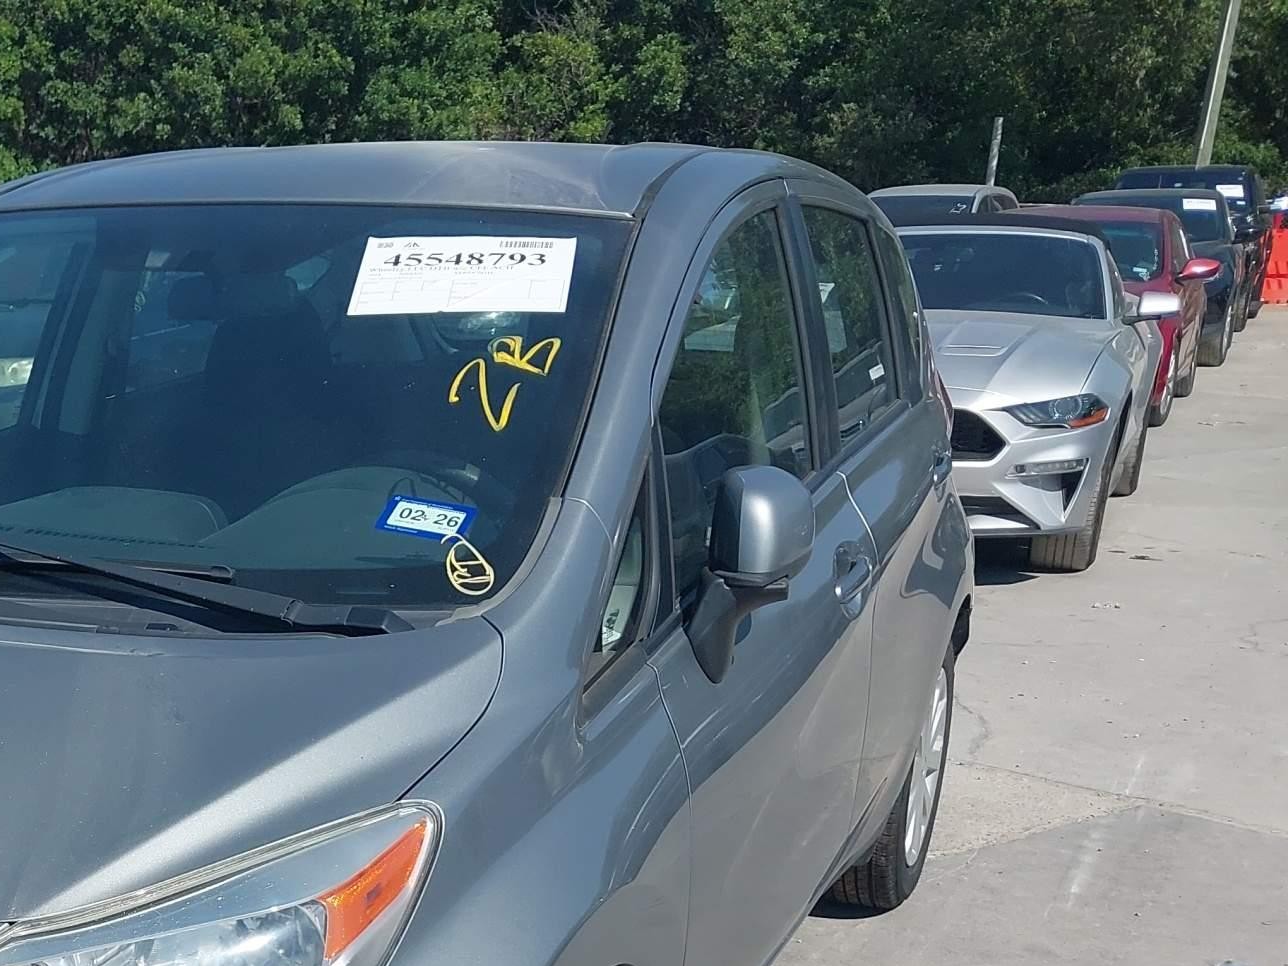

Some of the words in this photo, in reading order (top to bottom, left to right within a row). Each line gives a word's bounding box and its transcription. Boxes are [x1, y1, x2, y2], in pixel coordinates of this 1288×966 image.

[383, 252, 547, 267] 45548793
[398, 507, 425, 521] 02
[432, 513, 461, 528] 26
